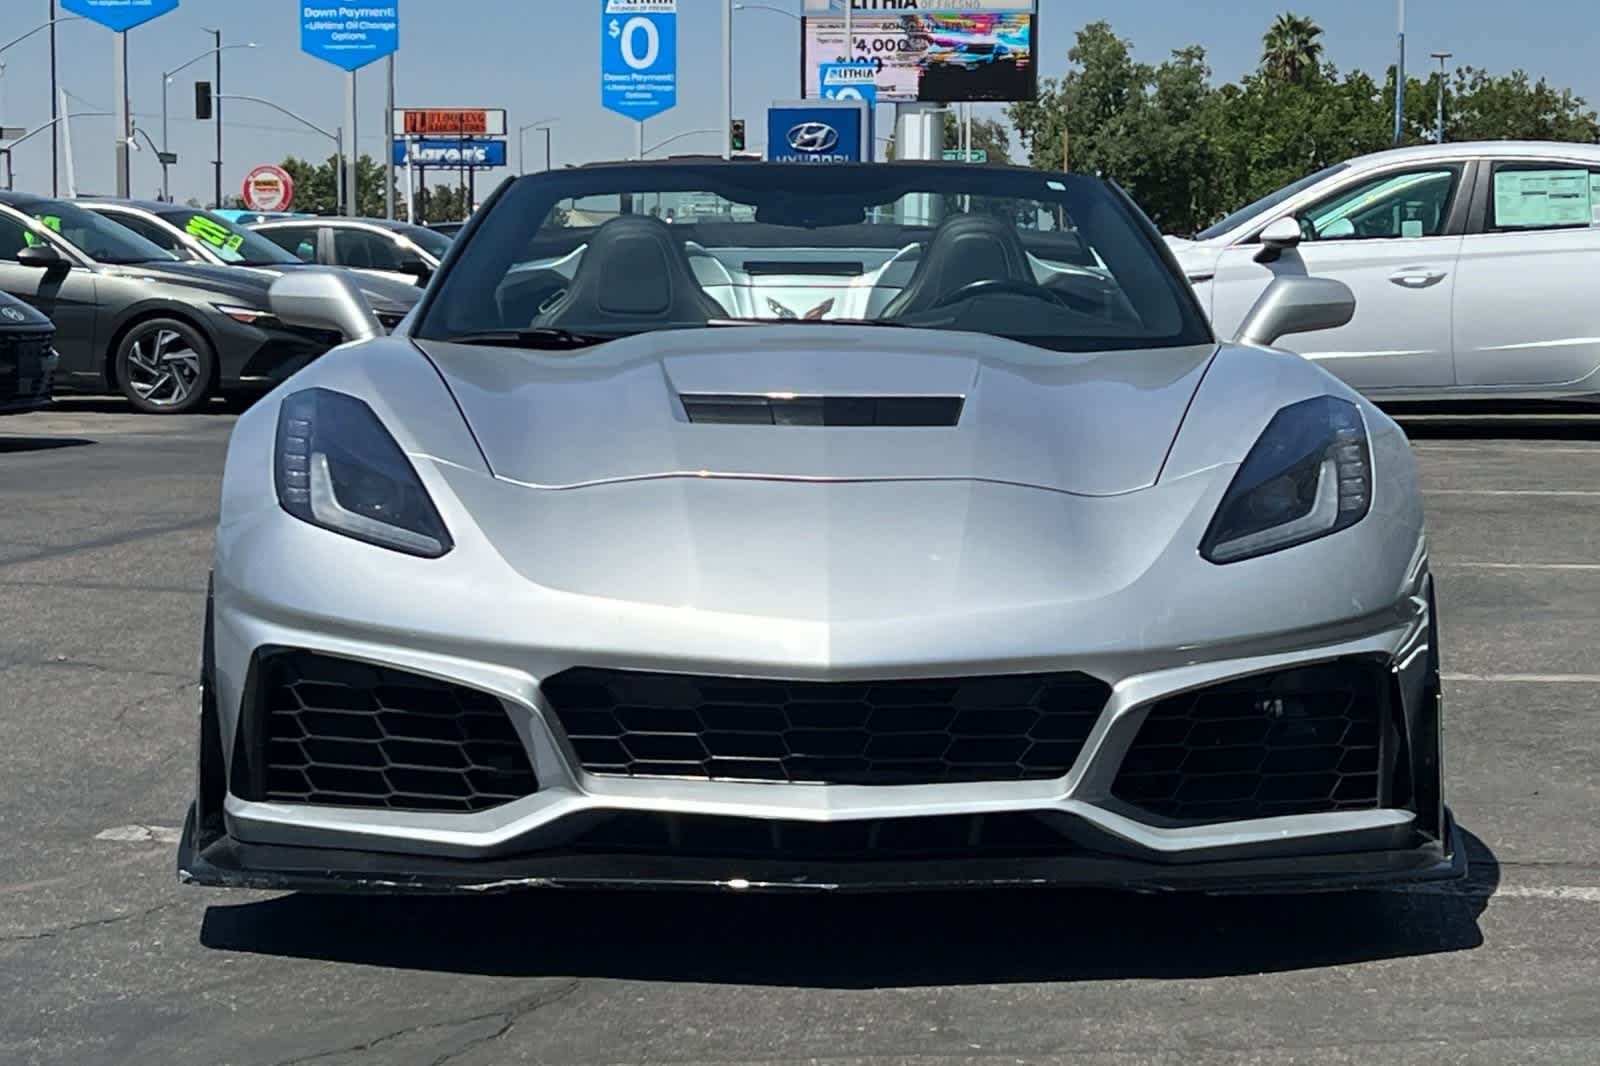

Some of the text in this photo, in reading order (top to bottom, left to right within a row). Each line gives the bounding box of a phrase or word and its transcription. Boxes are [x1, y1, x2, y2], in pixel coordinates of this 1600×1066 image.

[304, 7, 337, 18] Down
[359, 21, 396, 31] Change
[331, 31, 367, 41] Options
[608, 16, 660, 70] $0
[604, 73, 630, 81] Down
[839, 68, 875, 79] LITHIA
